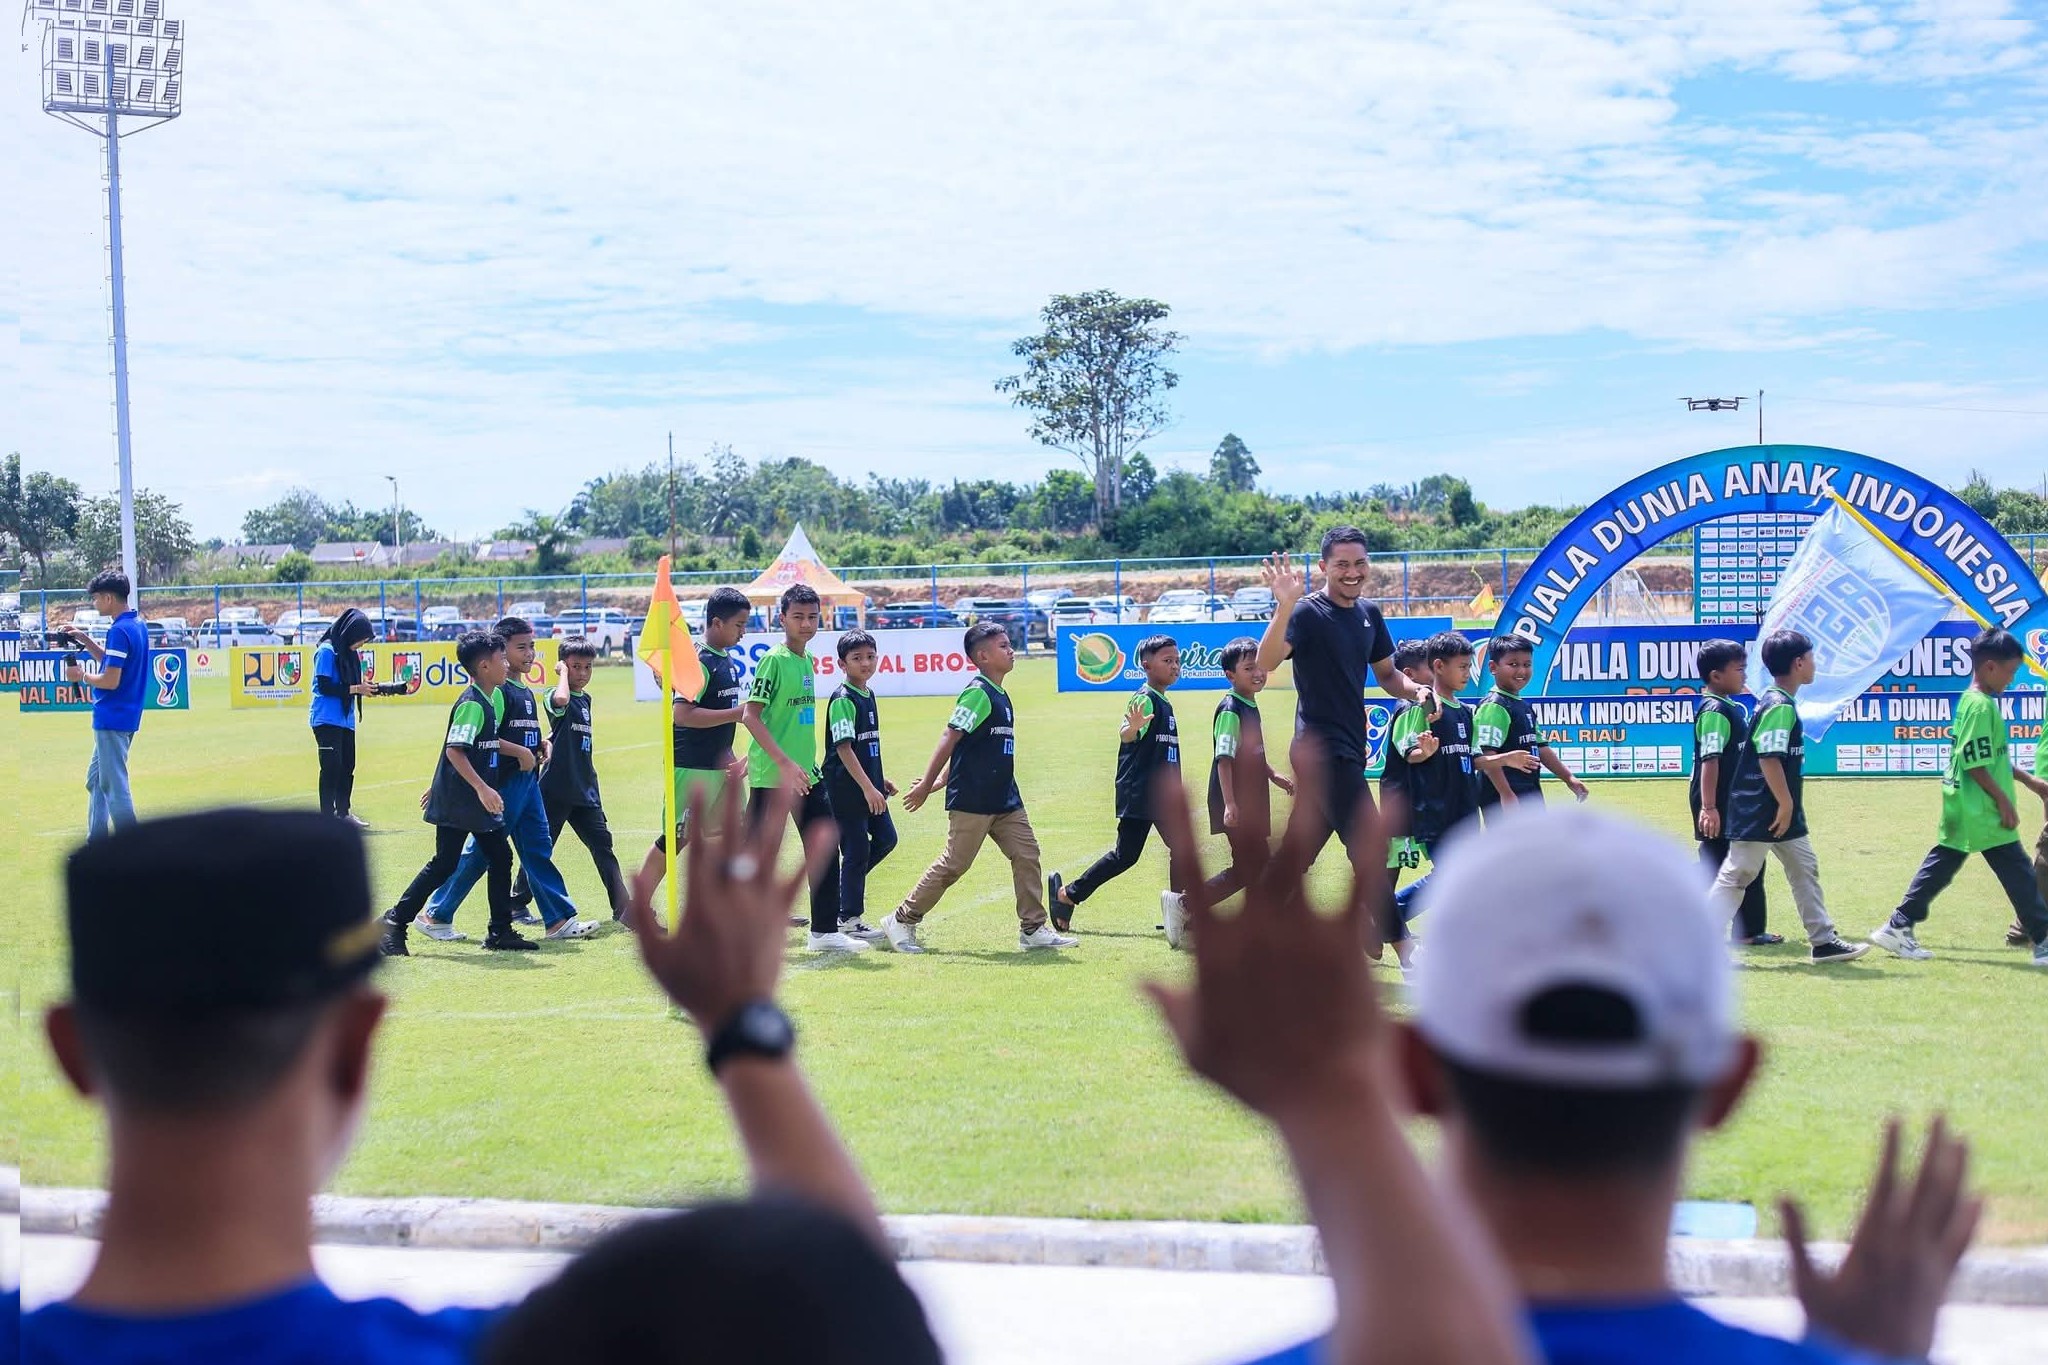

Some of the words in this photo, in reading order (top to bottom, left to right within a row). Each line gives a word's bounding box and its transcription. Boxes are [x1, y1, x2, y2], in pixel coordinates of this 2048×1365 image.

[1513, 545, 1599, 645] PIALA
[1592, 473, 1713, 553] DUNIA
[1724, 462, 1839, 498] ANAK
[1846, 473, 2030, 628] INDONESIA
[1553, 642, 1628, 681] IALA
[1640, 641, 1700, 679] DUN
[1590, 701, 1694, 725] INDONESIA
[1889, 698, 1951, 721] DUNIA
[1579, 729, 1626, 742] RIAU
[2010, 725, 2043, 739] RIA
